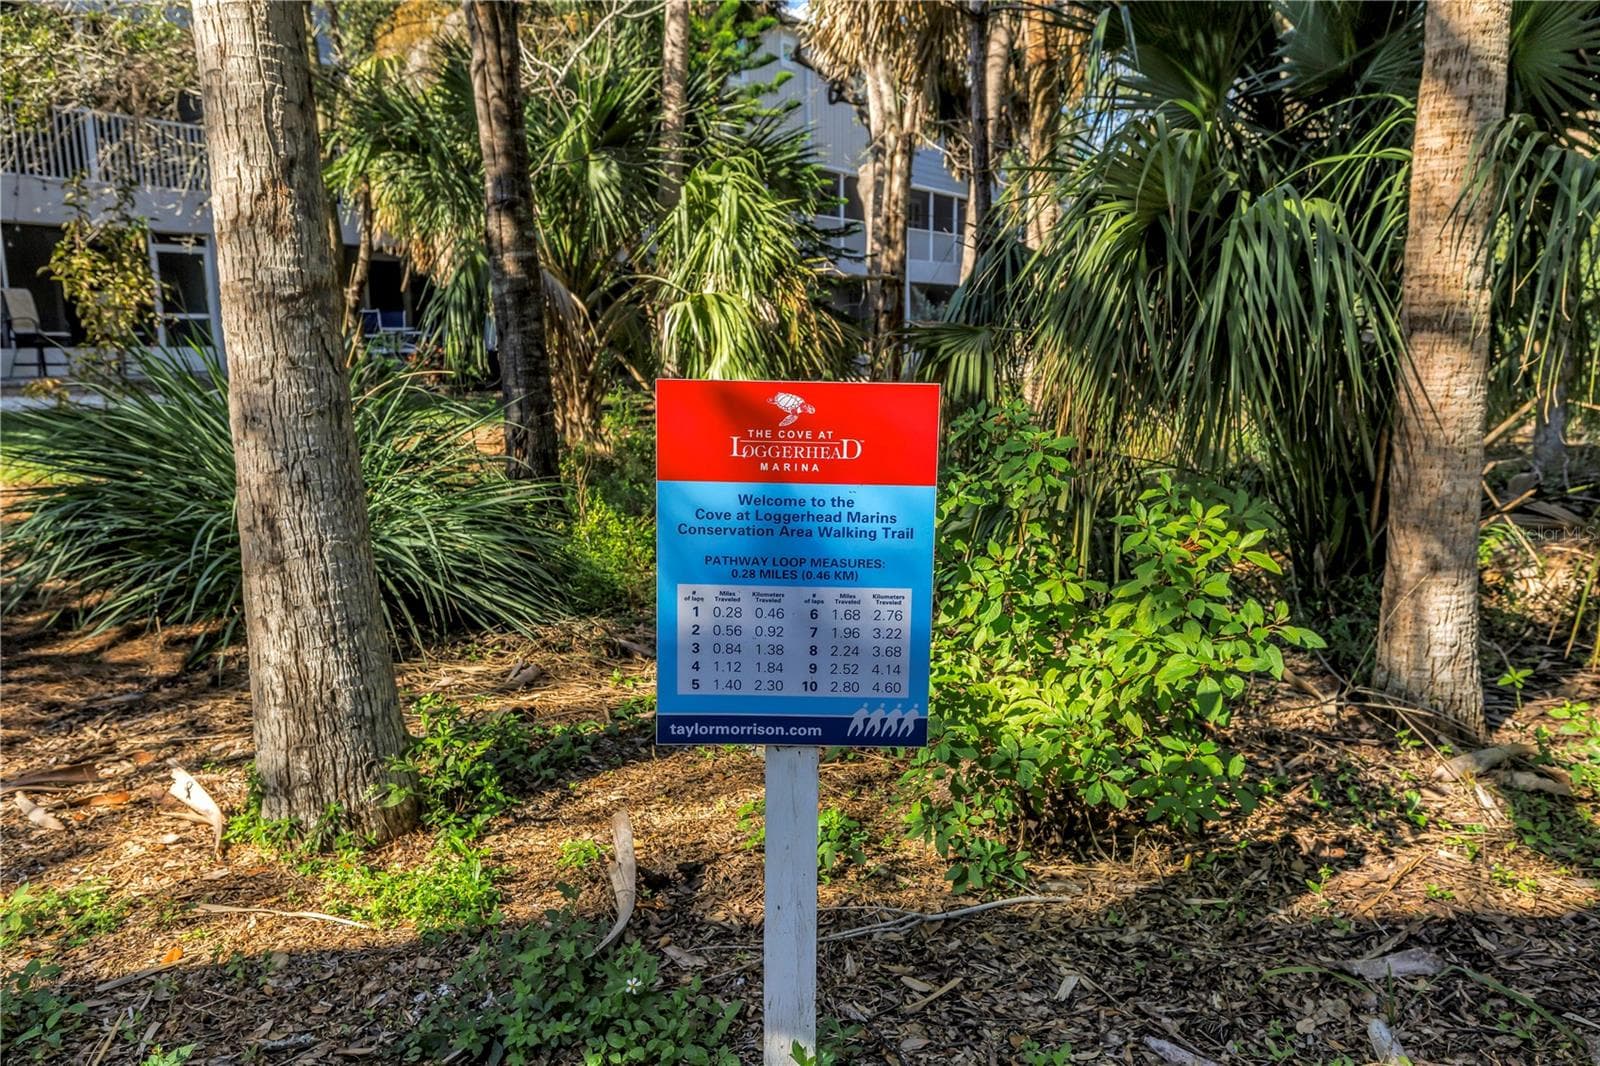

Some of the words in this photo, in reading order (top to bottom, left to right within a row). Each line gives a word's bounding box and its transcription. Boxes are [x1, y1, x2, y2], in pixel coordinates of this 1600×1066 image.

[748, 429, 772, 438] THE
[778, 430, 812, 440] COVE
[818, 430, 834, 440] AT
[760, 462, 820, 472] MARINA
[738, 494, 806, 508] Welcome
[810, 496, 826, 508] to
[830, 495, 854, 508] the
[695, 508, 732, 522] Cove
[736, 510, 750, 522] at
[755, 510, 842, 526] Loggerhead
[847, 511, 897, 524] Marins
[678, 523, 774, 537] Conservation
[779, 526, 813, 538] Area
[818, 526, 877, 541] Walking
[882, 527, 914, 540] Trail
[704, 556, 769, 567] PATHWAY
[772, 557, 807, 568] LOOP
[810, 558, 885, 569] MEASURES:
[731, 569, 756, 580] 0.28
[759, 570, 798, 580] MILES
[801, 570, 830, 581] (0.46
[834, 570, 858, 582] KM)
[692, 606, 699, 617] 1
[713, 606, 742, 618] 0.28
[755, 607, 785, 619] 0.46
[810, 609, 818, 620] 6
[833, 609, 861, 621] 1.68
[874, 610, 903, 621] 2.76
[692, 624, 700, 635] 2
[713, 625, 742, 637] 0.56
[754, 626, 784, 638] 0.92
[810, 627, 818, 638] 7
[832, 628, 860, 639] 1.96
[873, 628, 902, 640] 3.22
[692, 643, 700, 654] 3
[713, 643, 742, 655] 0.84
[756, 644, 784, 655] 1.38
[809, 646, 818, 656] 8
[830, 646, 859, 657] 2.24
[872, 646, 902, 658] 3.68
[692, 661, 700, 672] 4
[714, 661, 742, 673] 1.12
[756, 662, 783, 673] 1.84
[809, 664, 817, 674] 9
[830, 664, 859, 675] 2.52
[871, 664, 901, 676] 4.14
[692, 679, 700, 690] 5
[714, 679, 742, 691] 1.40
[754, 680, 784, 692] 2.30
[802, 681, 818, 692] 10
[830, 682, 860, 694] 2.80
[872, 682, 902, 694] 4.60
[670, 722, 822, 738] taylormorrison.com
